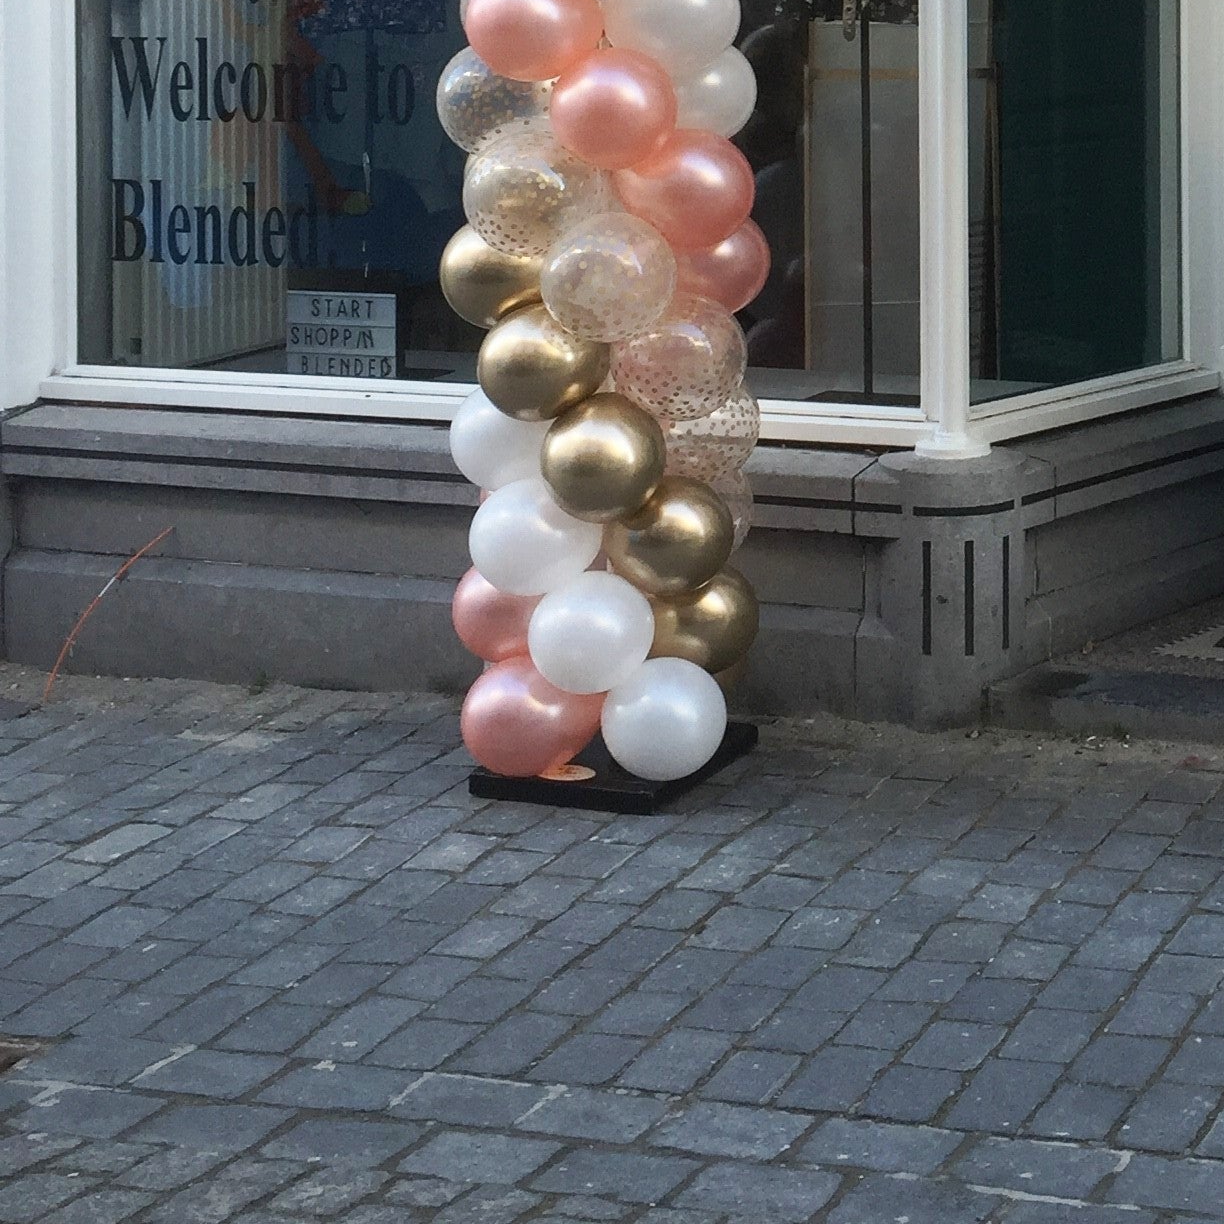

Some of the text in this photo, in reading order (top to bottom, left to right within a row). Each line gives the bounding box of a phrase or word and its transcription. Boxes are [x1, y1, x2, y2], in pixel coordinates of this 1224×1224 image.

[110, 36, 416, 126] Welcome to
[311, 298, 373, 319] START
[301, 355, 393, 377] BLENDED
